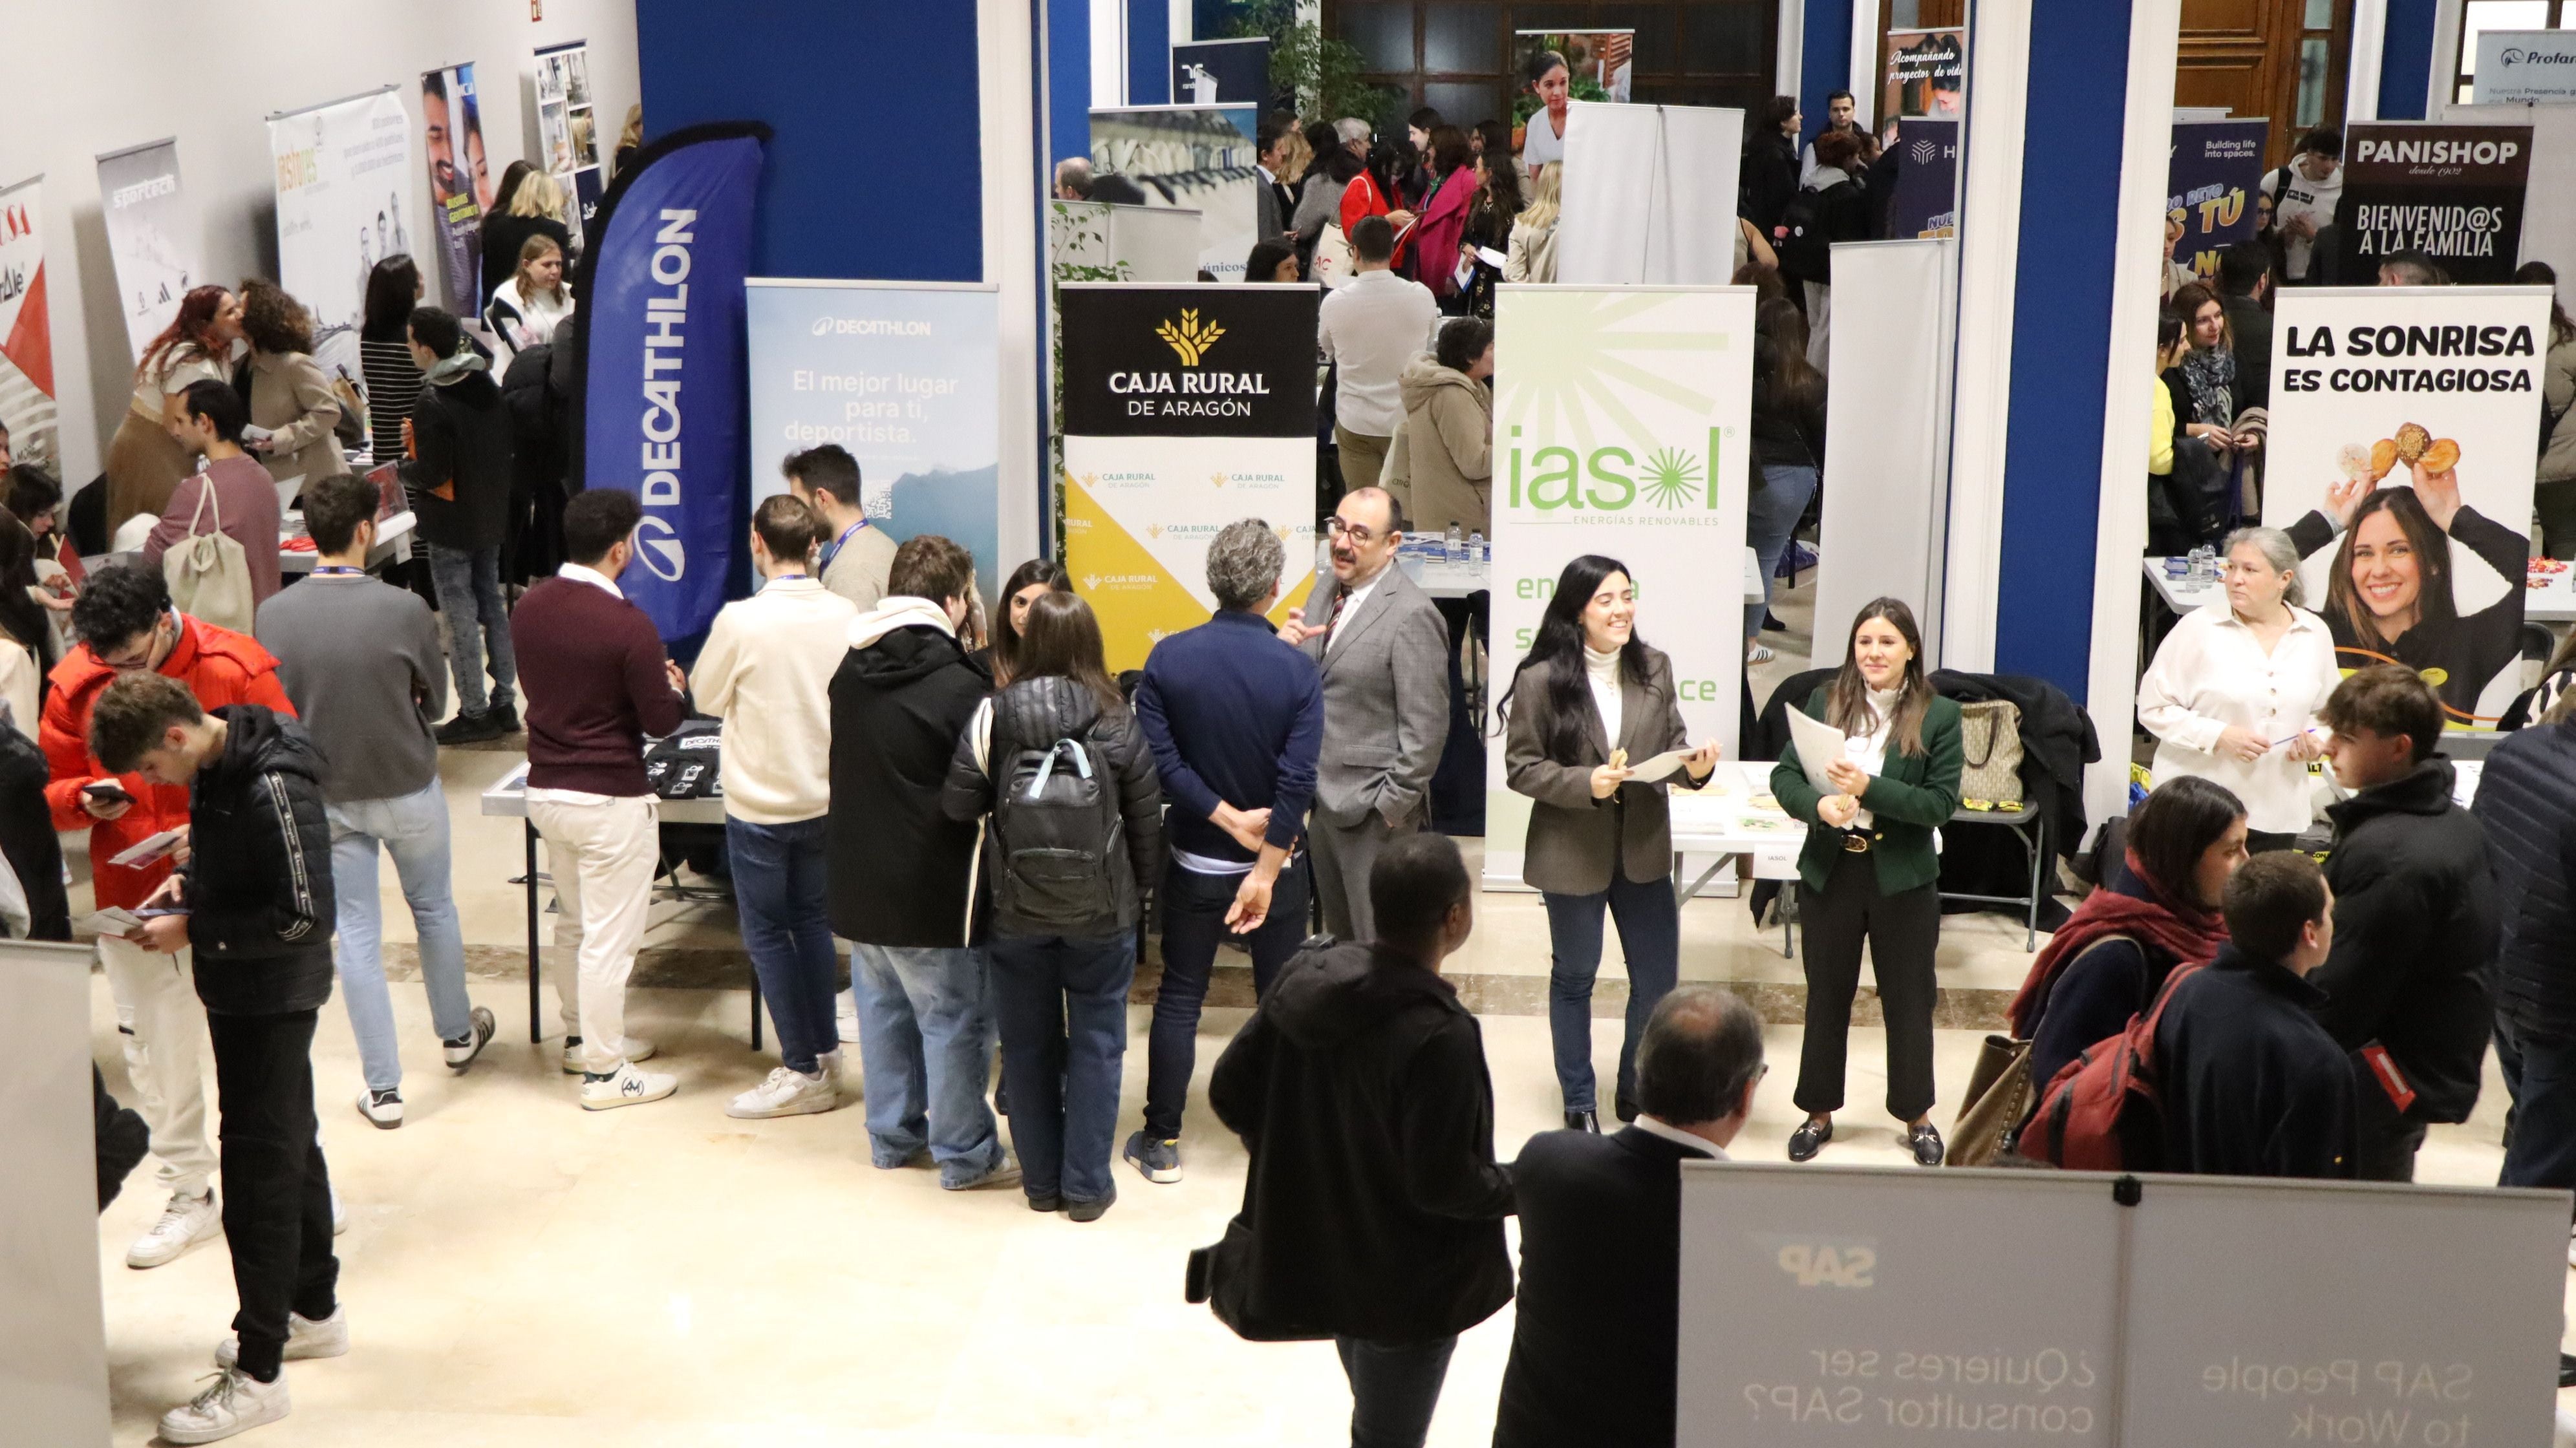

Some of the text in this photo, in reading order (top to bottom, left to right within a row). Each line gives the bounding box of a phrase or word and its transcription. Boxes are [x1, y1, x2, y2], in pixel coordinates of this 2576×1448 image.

[1890, 47, 1955, 67] Acompañando
[1887, 69, 1930, 85] proyectos
[1935, 64, 1945, 77] de
[2205, 149, 2255, 160] into spaces.
[2206, 140, 2256, 151] Building life
[2357, 140, 2518, 164] PANISHOP
[2409, 165, 2462, 176] desde 1902
[2187, 184, 2224, 207] RETO
[2199, 187, 2246, 233] TÚ
[2357, 204, 2503, 233] BIENVENID@S
[2359, 230, 2373, 255] A
[2413, 231, 2493, 257] FAMILIA
[836, 319, 931, 335] DECATHLON
[2287, 325, 2535, 357] LA SONRISA
[642, 209, 698, 506] DECATHLON
[793, 370, 959, 399] El mejor lugar
[1109, 372, 1270, 394] CAJA RURAL
[2284, 368, 2532, 392] ES CONTAGIOSA
[846, 398, 928, 423] para ti,
[1128, 398, 1251, 416] DE ARAGÓN
[784, 421, 917, 443] deportista.
[1102, 473, 1156, 482] CAJA RURAL
[1231, 474, 1285, 482] CAJA RURAL
[1167, 525, 1221, 534] CAJA RURAL
[1574, 515, 1719, 526] ENERGÍAS RENOVABLES
